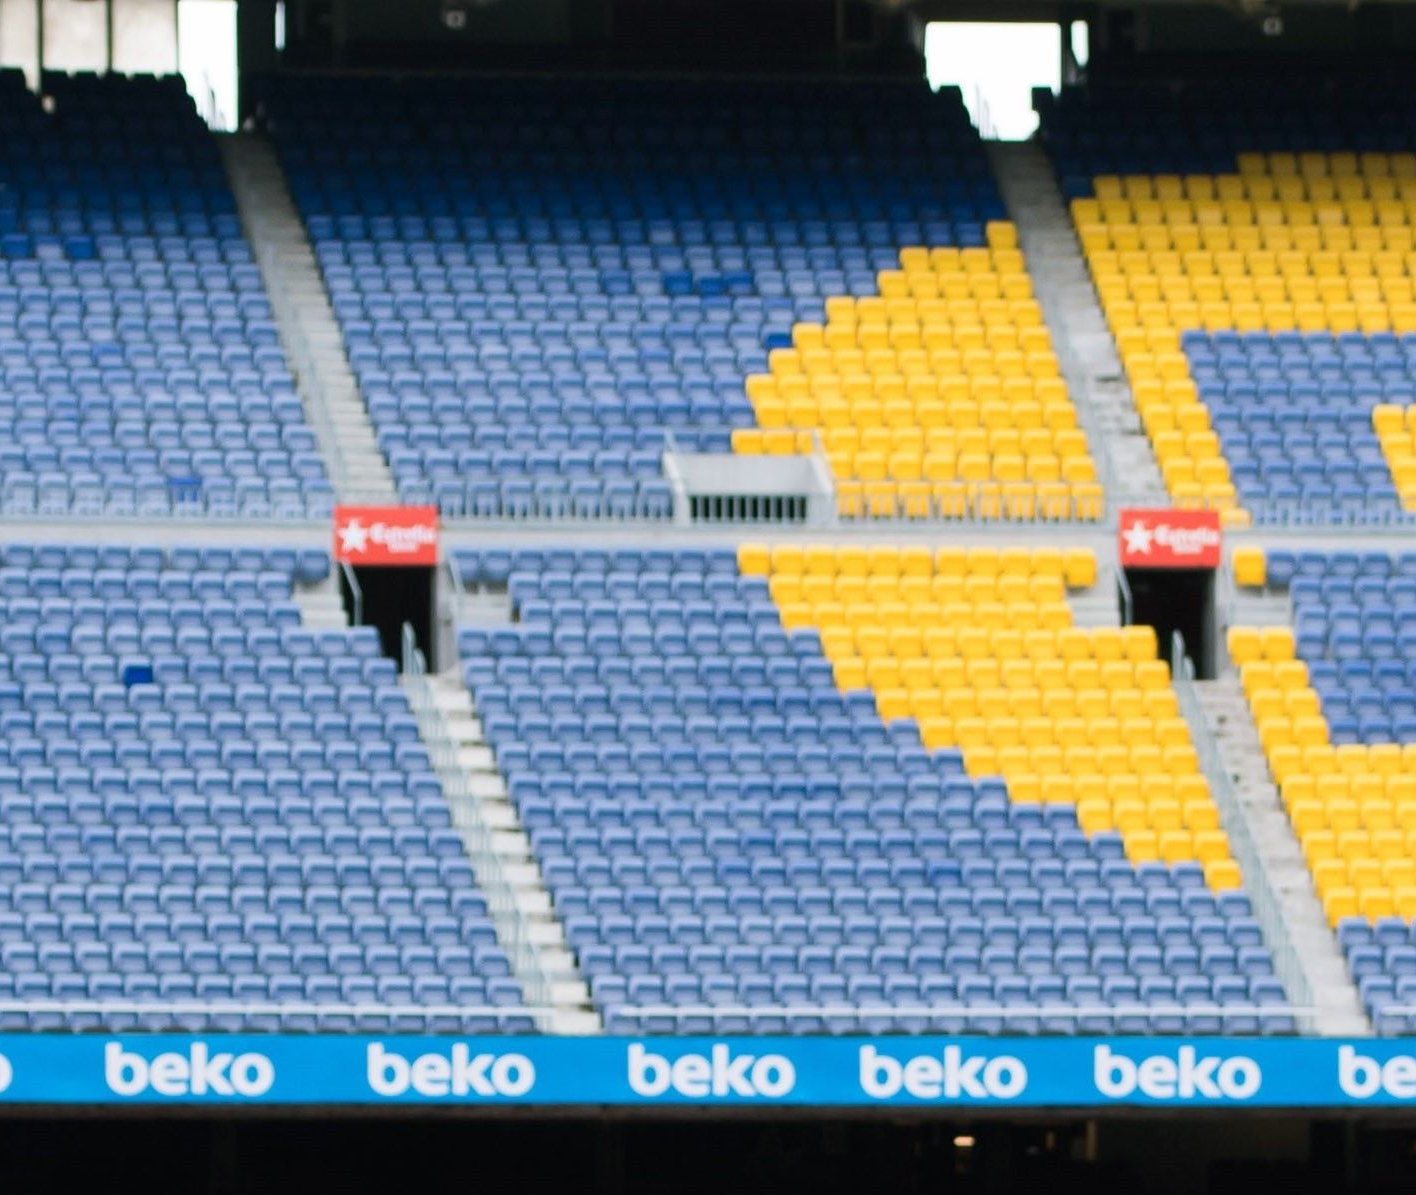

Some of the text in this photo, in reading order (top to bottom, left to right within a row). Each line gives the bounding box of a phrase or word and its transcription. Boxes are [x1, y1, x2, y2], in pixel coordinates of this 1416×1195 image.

[105, 1041, 274, 1096] beko
[367, 1042, 535, 1096] beko
[628, 1043, 795, 1097] beko
[859, 1045, 1027, 1098] beko
[1094, 1045, 1261, 1099] beko
